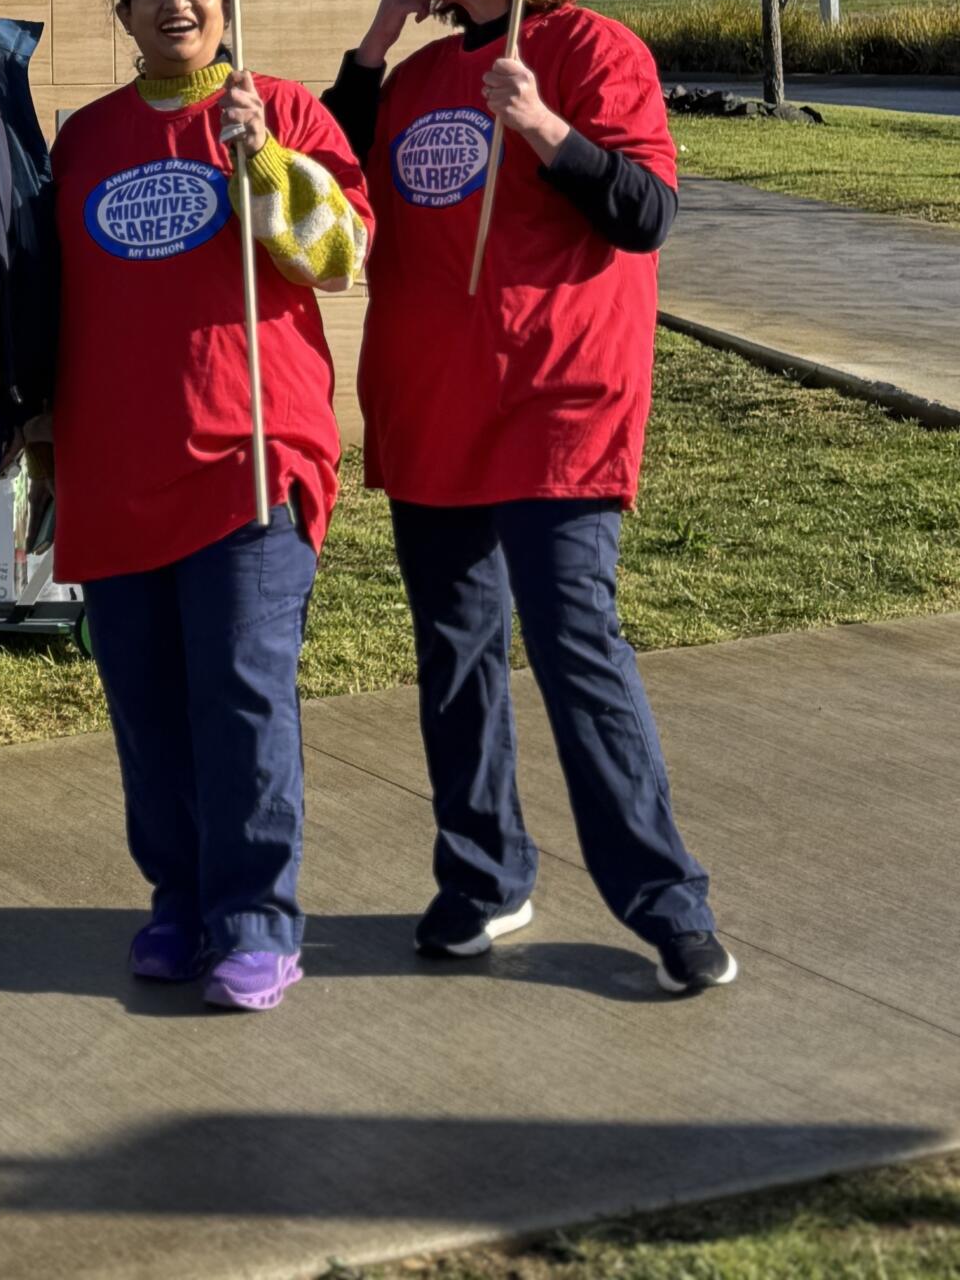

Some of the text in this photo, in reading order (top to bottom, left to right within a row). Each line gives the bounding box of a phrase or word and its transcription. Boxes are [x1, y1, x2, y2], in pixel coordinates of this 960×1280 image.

[436, 111, 453, 121] VIC
[454, 110, 491, 130] BRANCH
[403, 126, 479, 150] NURSES
[401, 147, 479, 166] MIDWIVES
[106, 160, 214, 190] ANMF VIC BRANCH
[403, 164, 474, 190] CARERS
[108, 175, 205, 205] NURSES
[413, 192, 461, 206] MY UNION
[106, 196, 208, 221] MIDWIVES
[108, 211, 204, 242] CARERS
[128, 241, 184, 257] MY UNION
